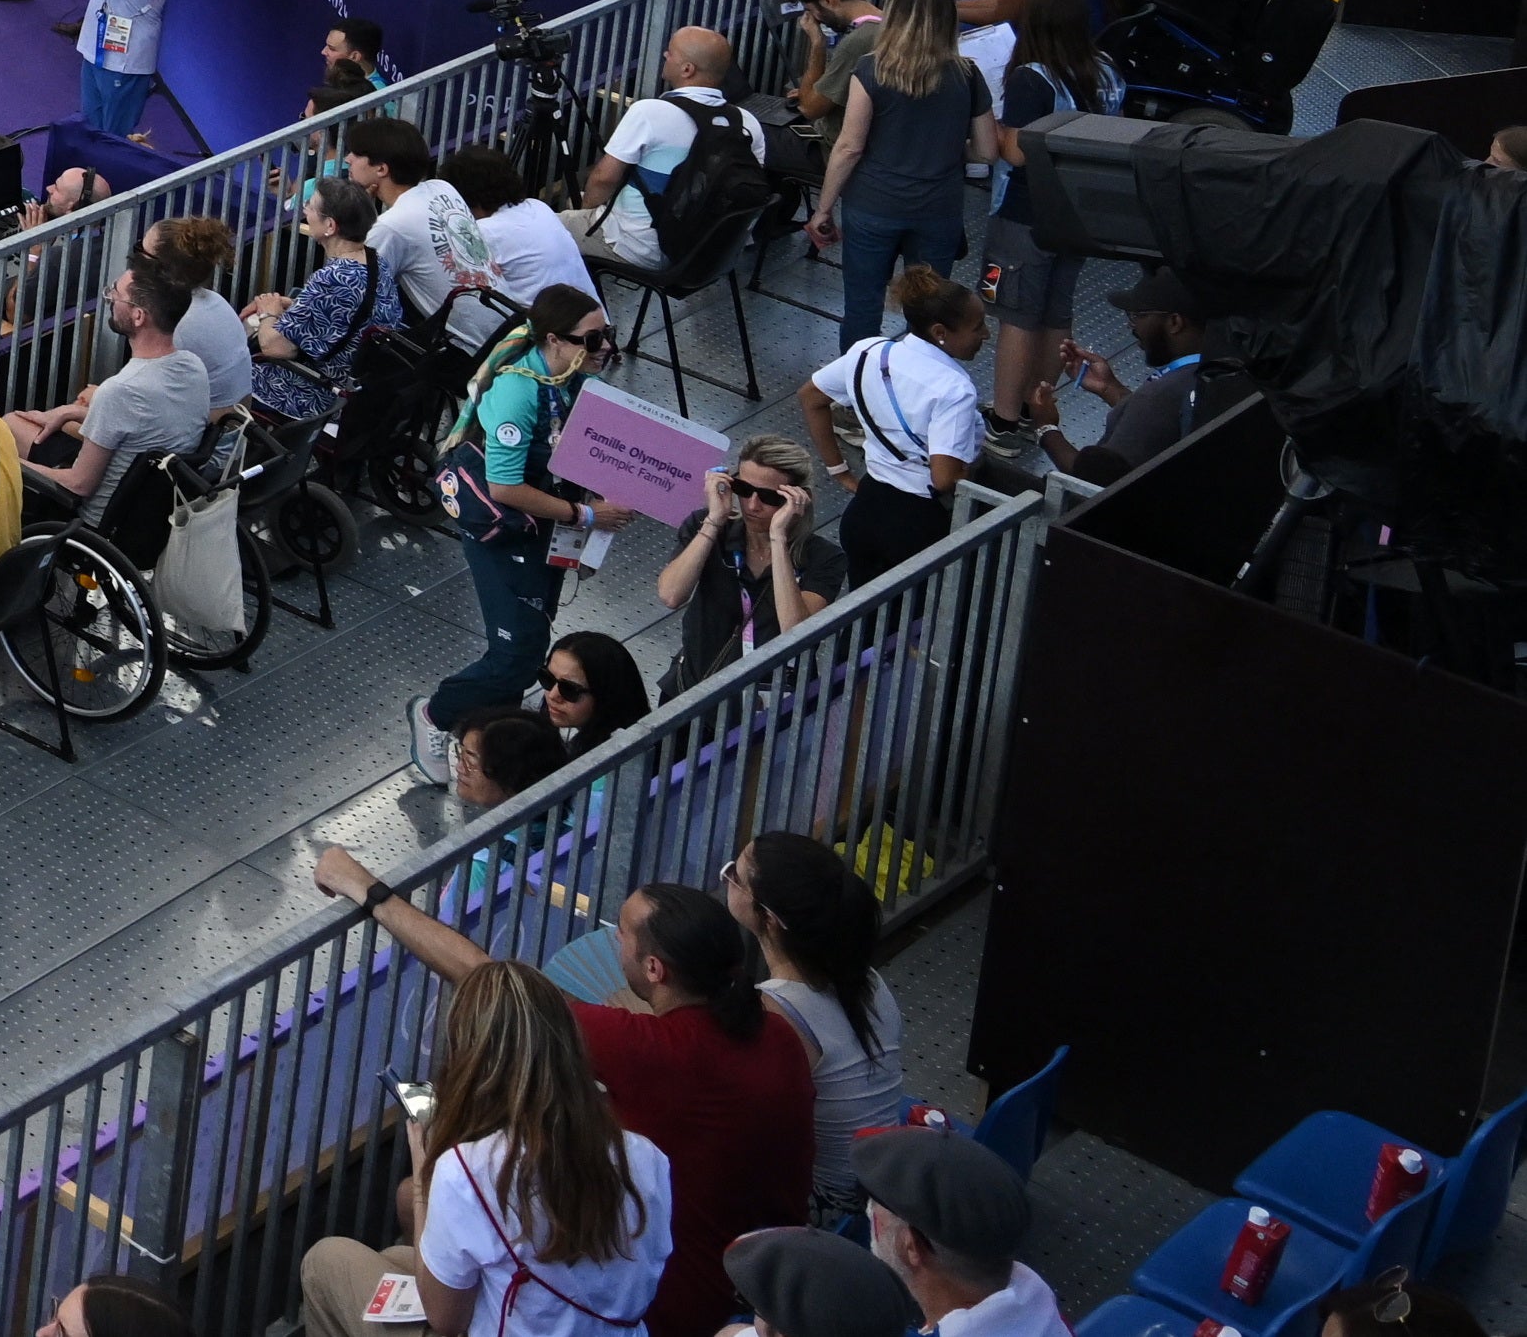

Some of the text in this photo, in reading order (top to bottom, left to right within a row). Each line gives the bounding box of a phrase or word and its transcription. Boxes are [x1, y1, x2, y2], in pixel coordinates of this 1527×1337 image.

[583, 426, 693, 482] Famille Olympique
[589, 446, 676, 493] Olympic Family
